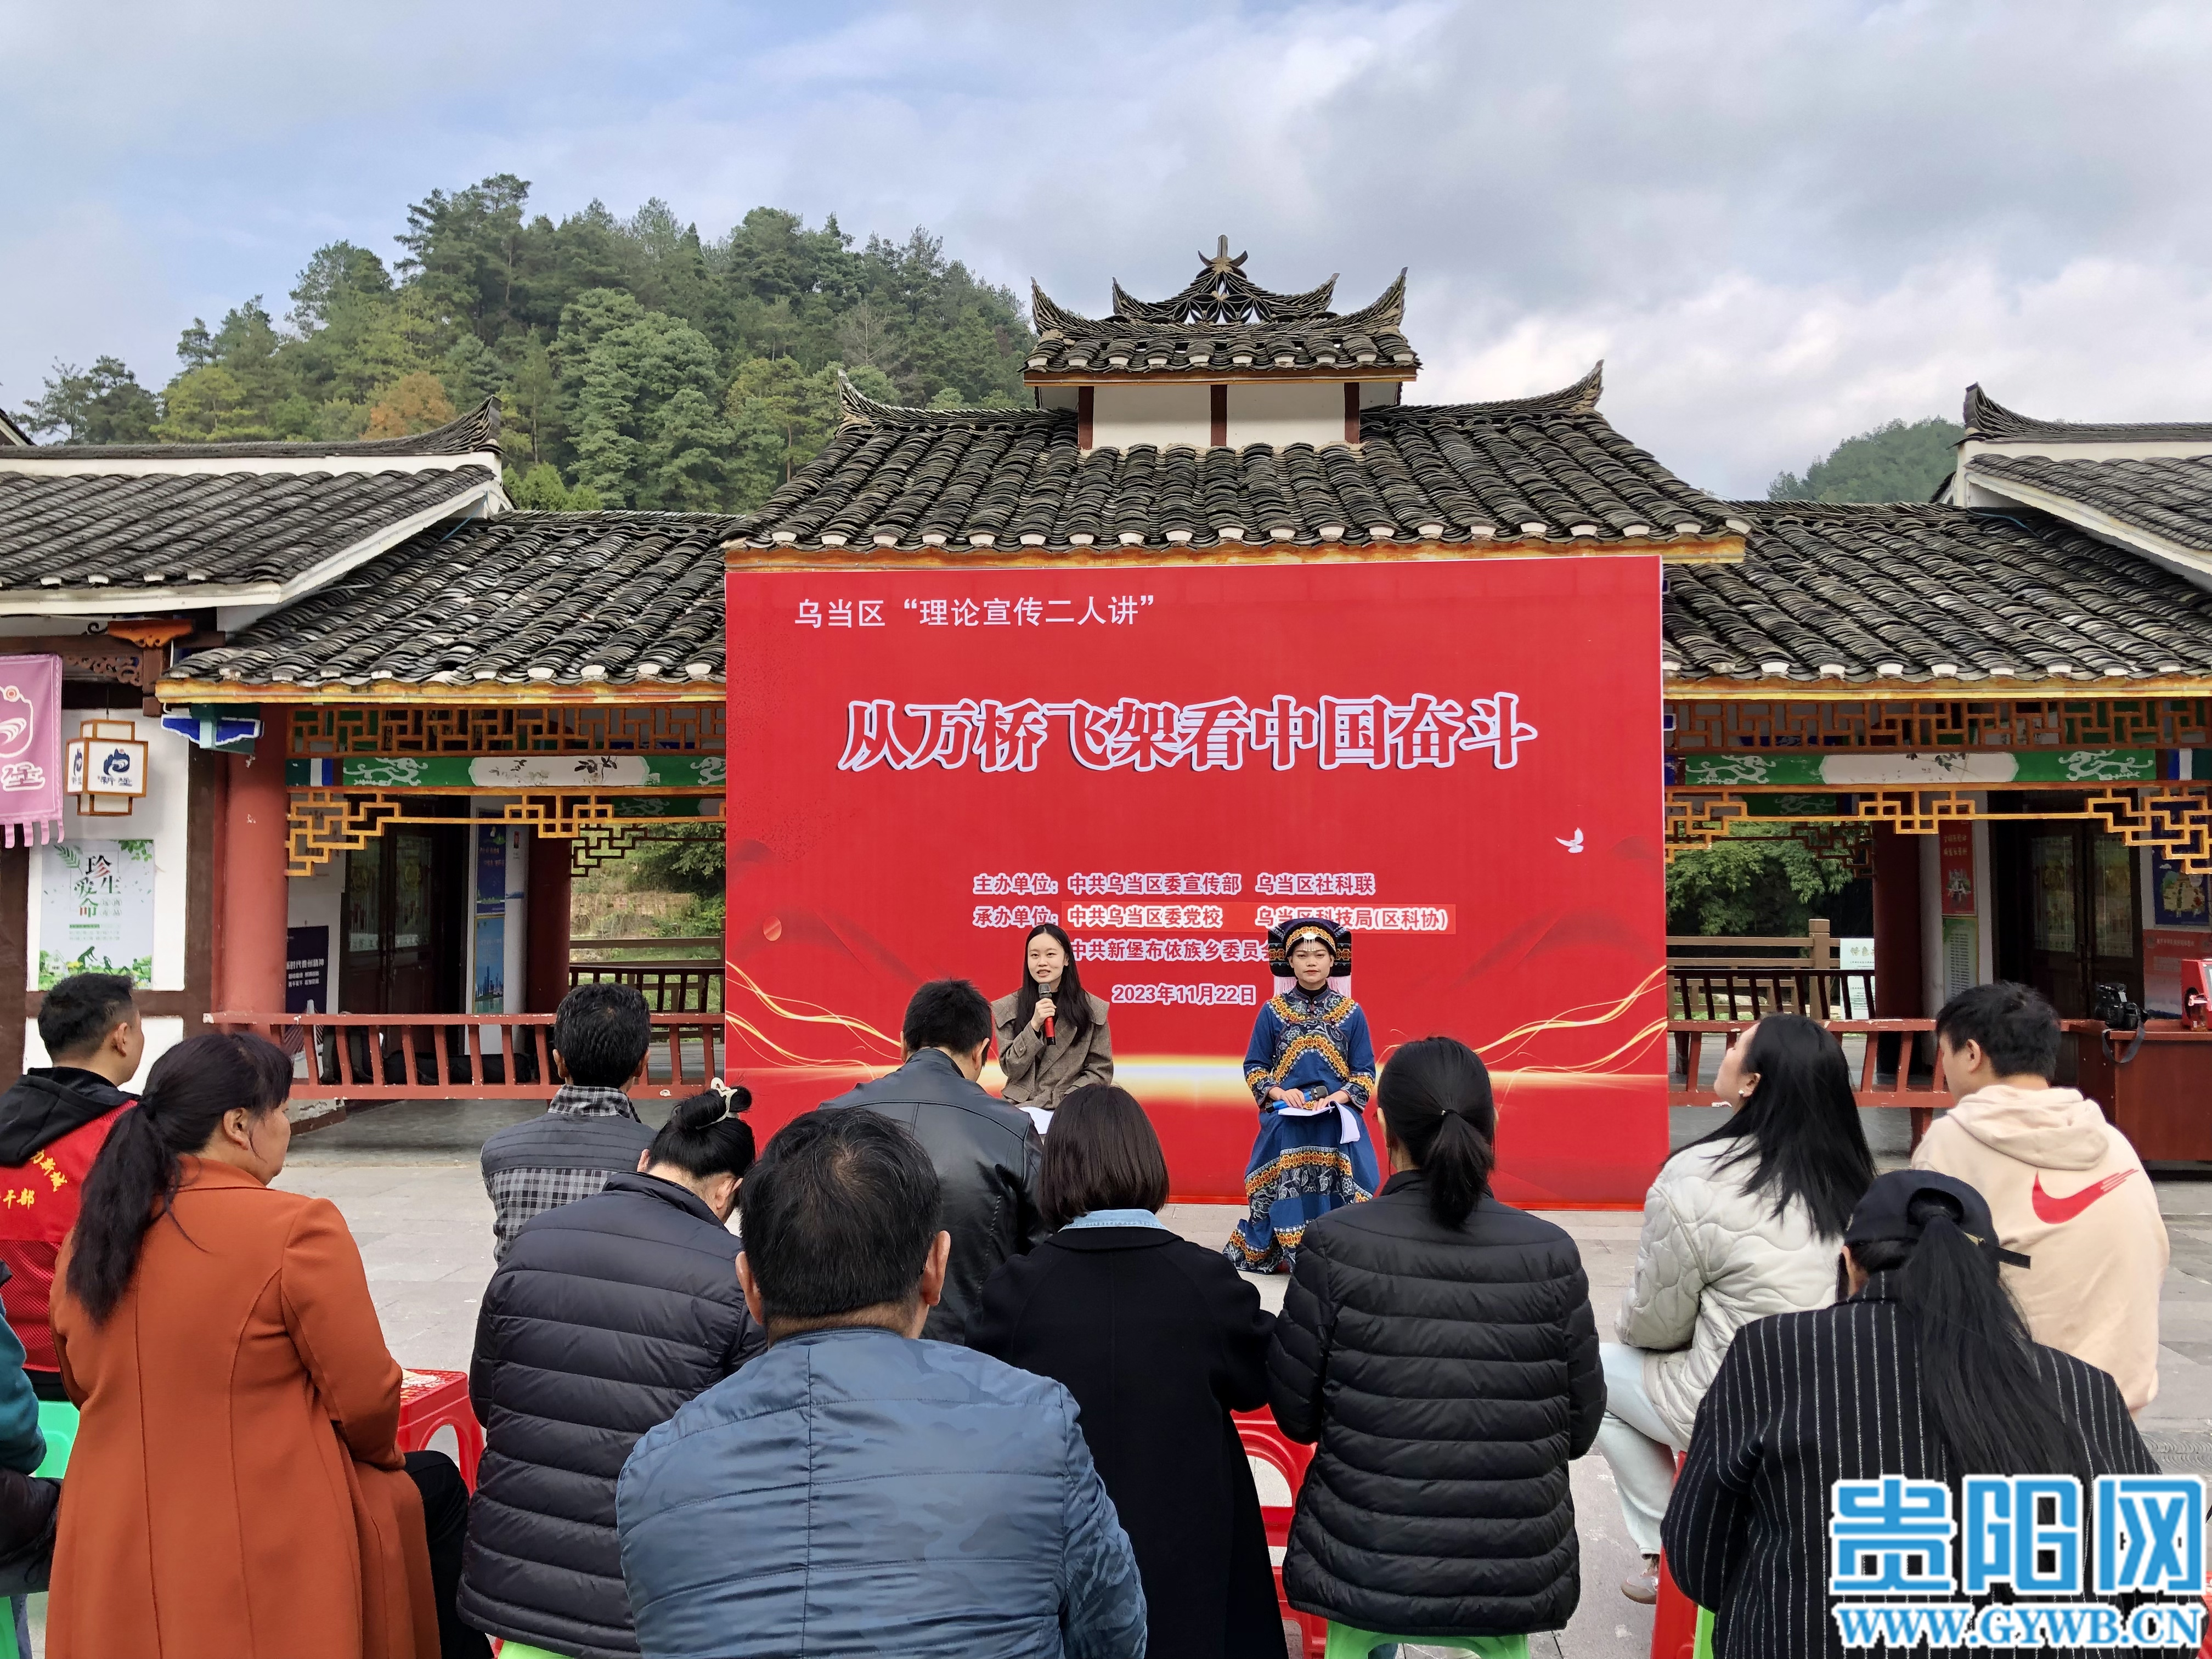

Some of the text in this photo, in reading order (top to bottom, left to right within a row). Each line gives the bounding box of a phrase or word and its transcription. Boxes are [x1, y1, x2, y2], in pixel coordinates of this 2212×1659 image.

[794, 595, 1154, 629] 乌当区 “理论宣传二人讲”
[837, 691, 1538, 773] 从万桥飞架看中国奋斗
[1067, 872, 1242, 895] 中共乌当区委宣传部
[1255, 872, 1376, 896] 乌当区社科联
[1067, 904, 1223, 929] 中共乌当区委党校
[1111, 982, 1256, 1006] 2023年11月22日
